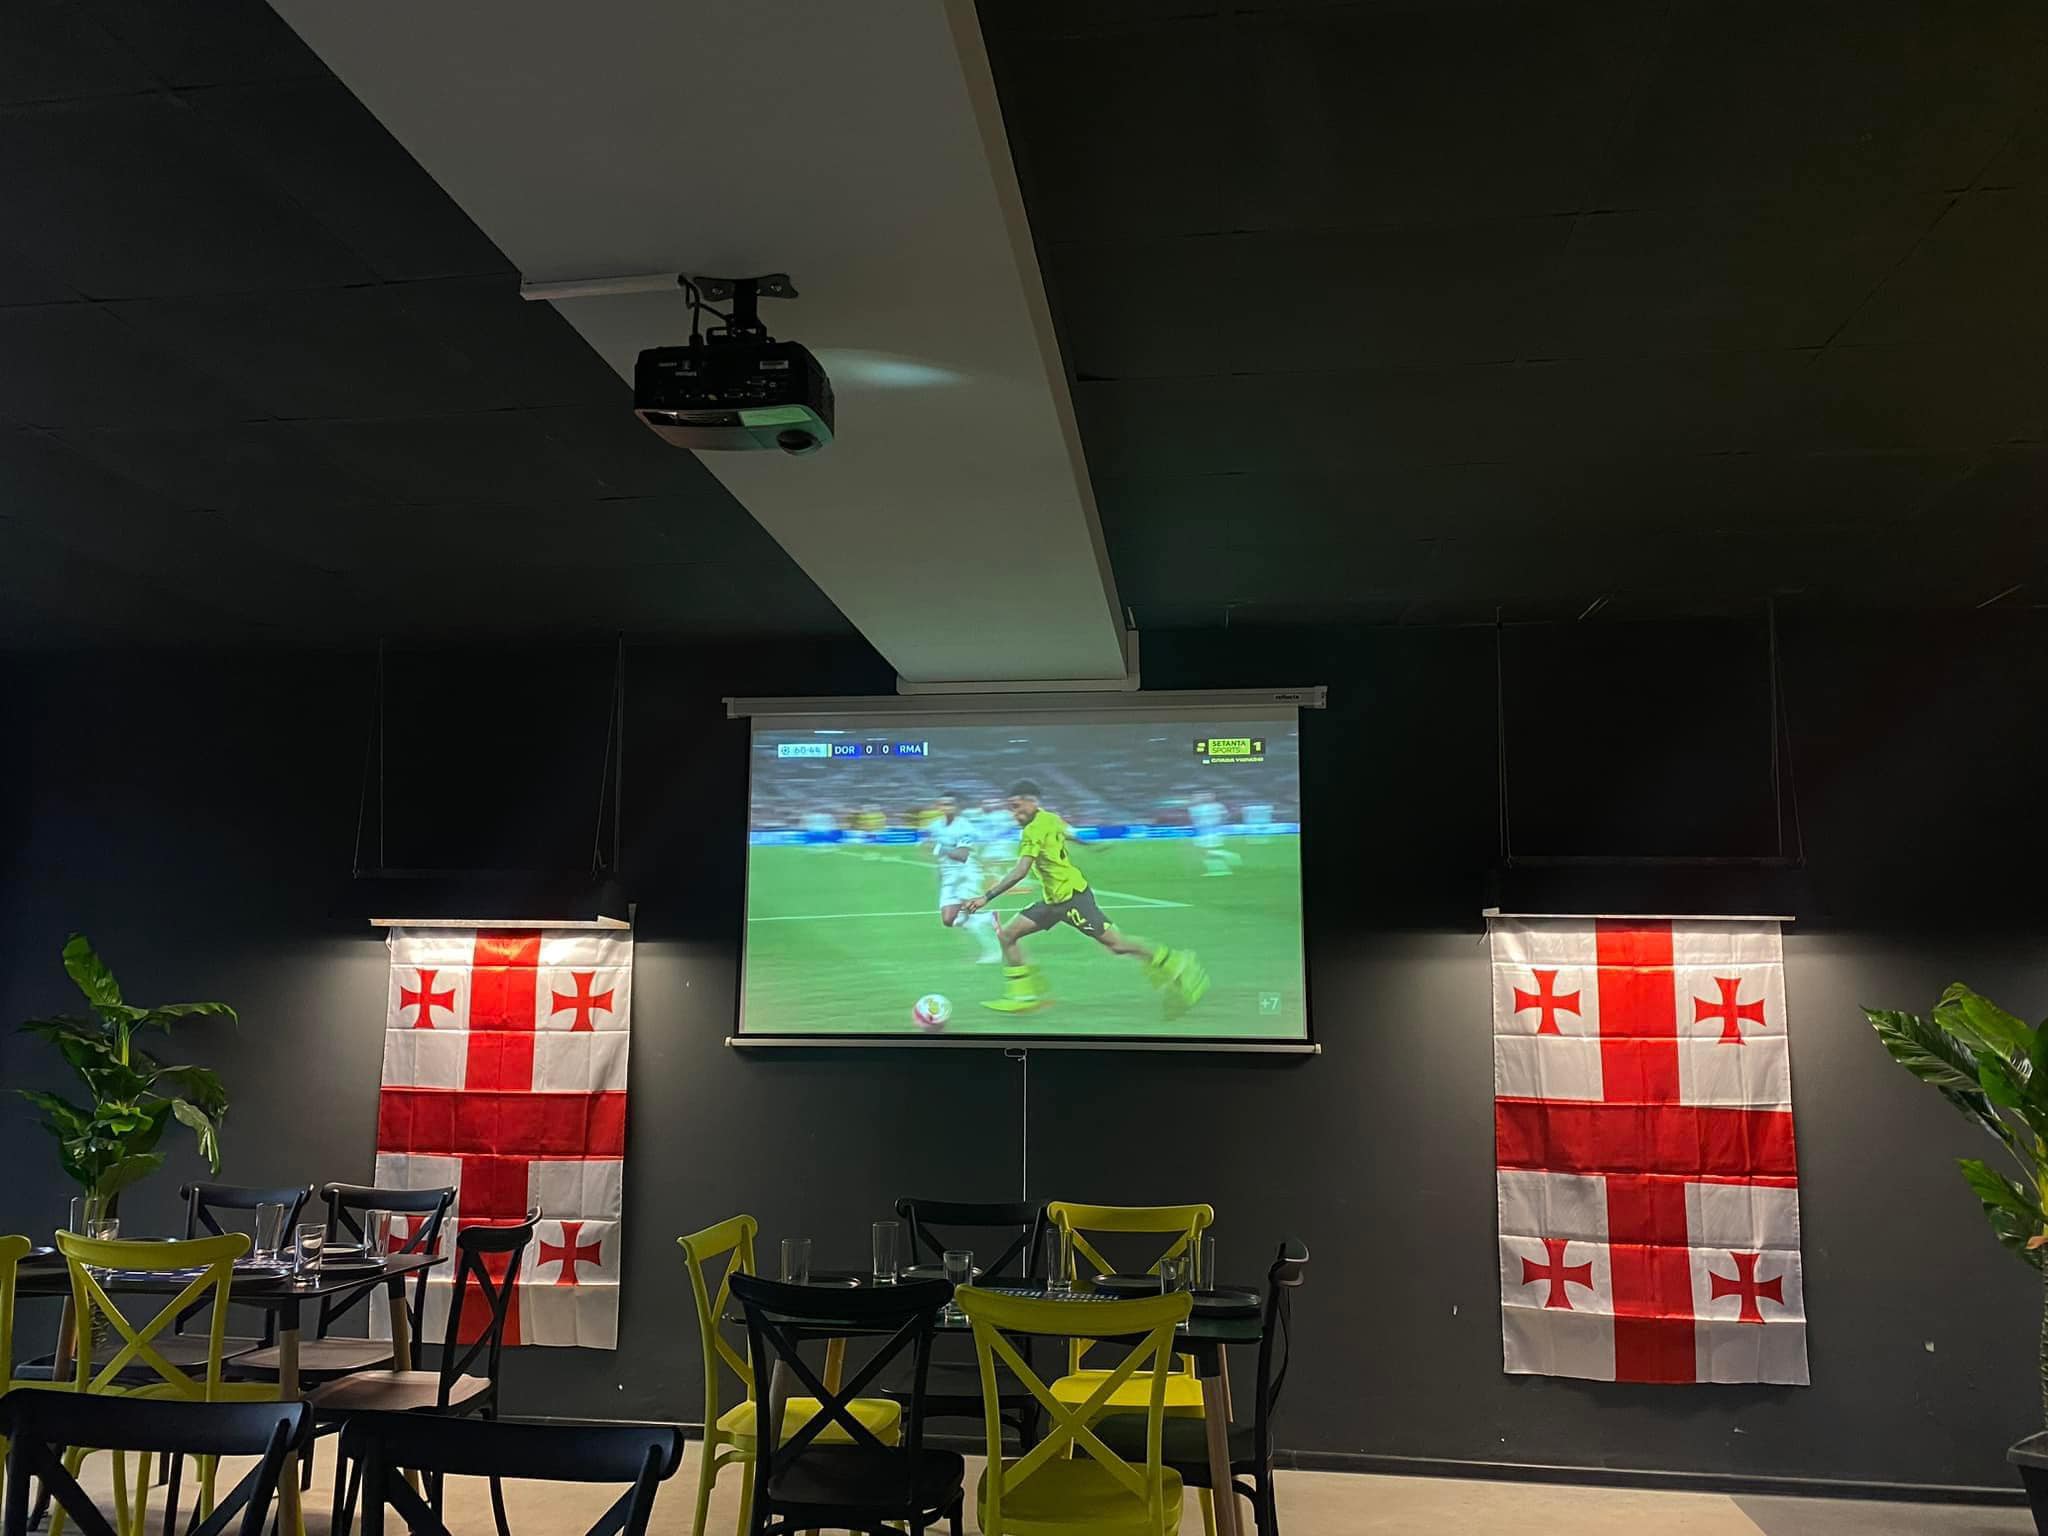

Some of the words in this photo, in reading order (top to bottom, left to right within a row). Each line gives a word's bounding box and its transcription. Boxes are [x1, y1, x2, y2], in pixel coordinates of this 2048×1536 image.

[834, 745, 856, 755] DOR
[865, 745, 873, 754] 0
[882, 744, 890, 754] 0
[899, 743, 922, 754] RMA
[1253, 741, 1262, 752] 1
